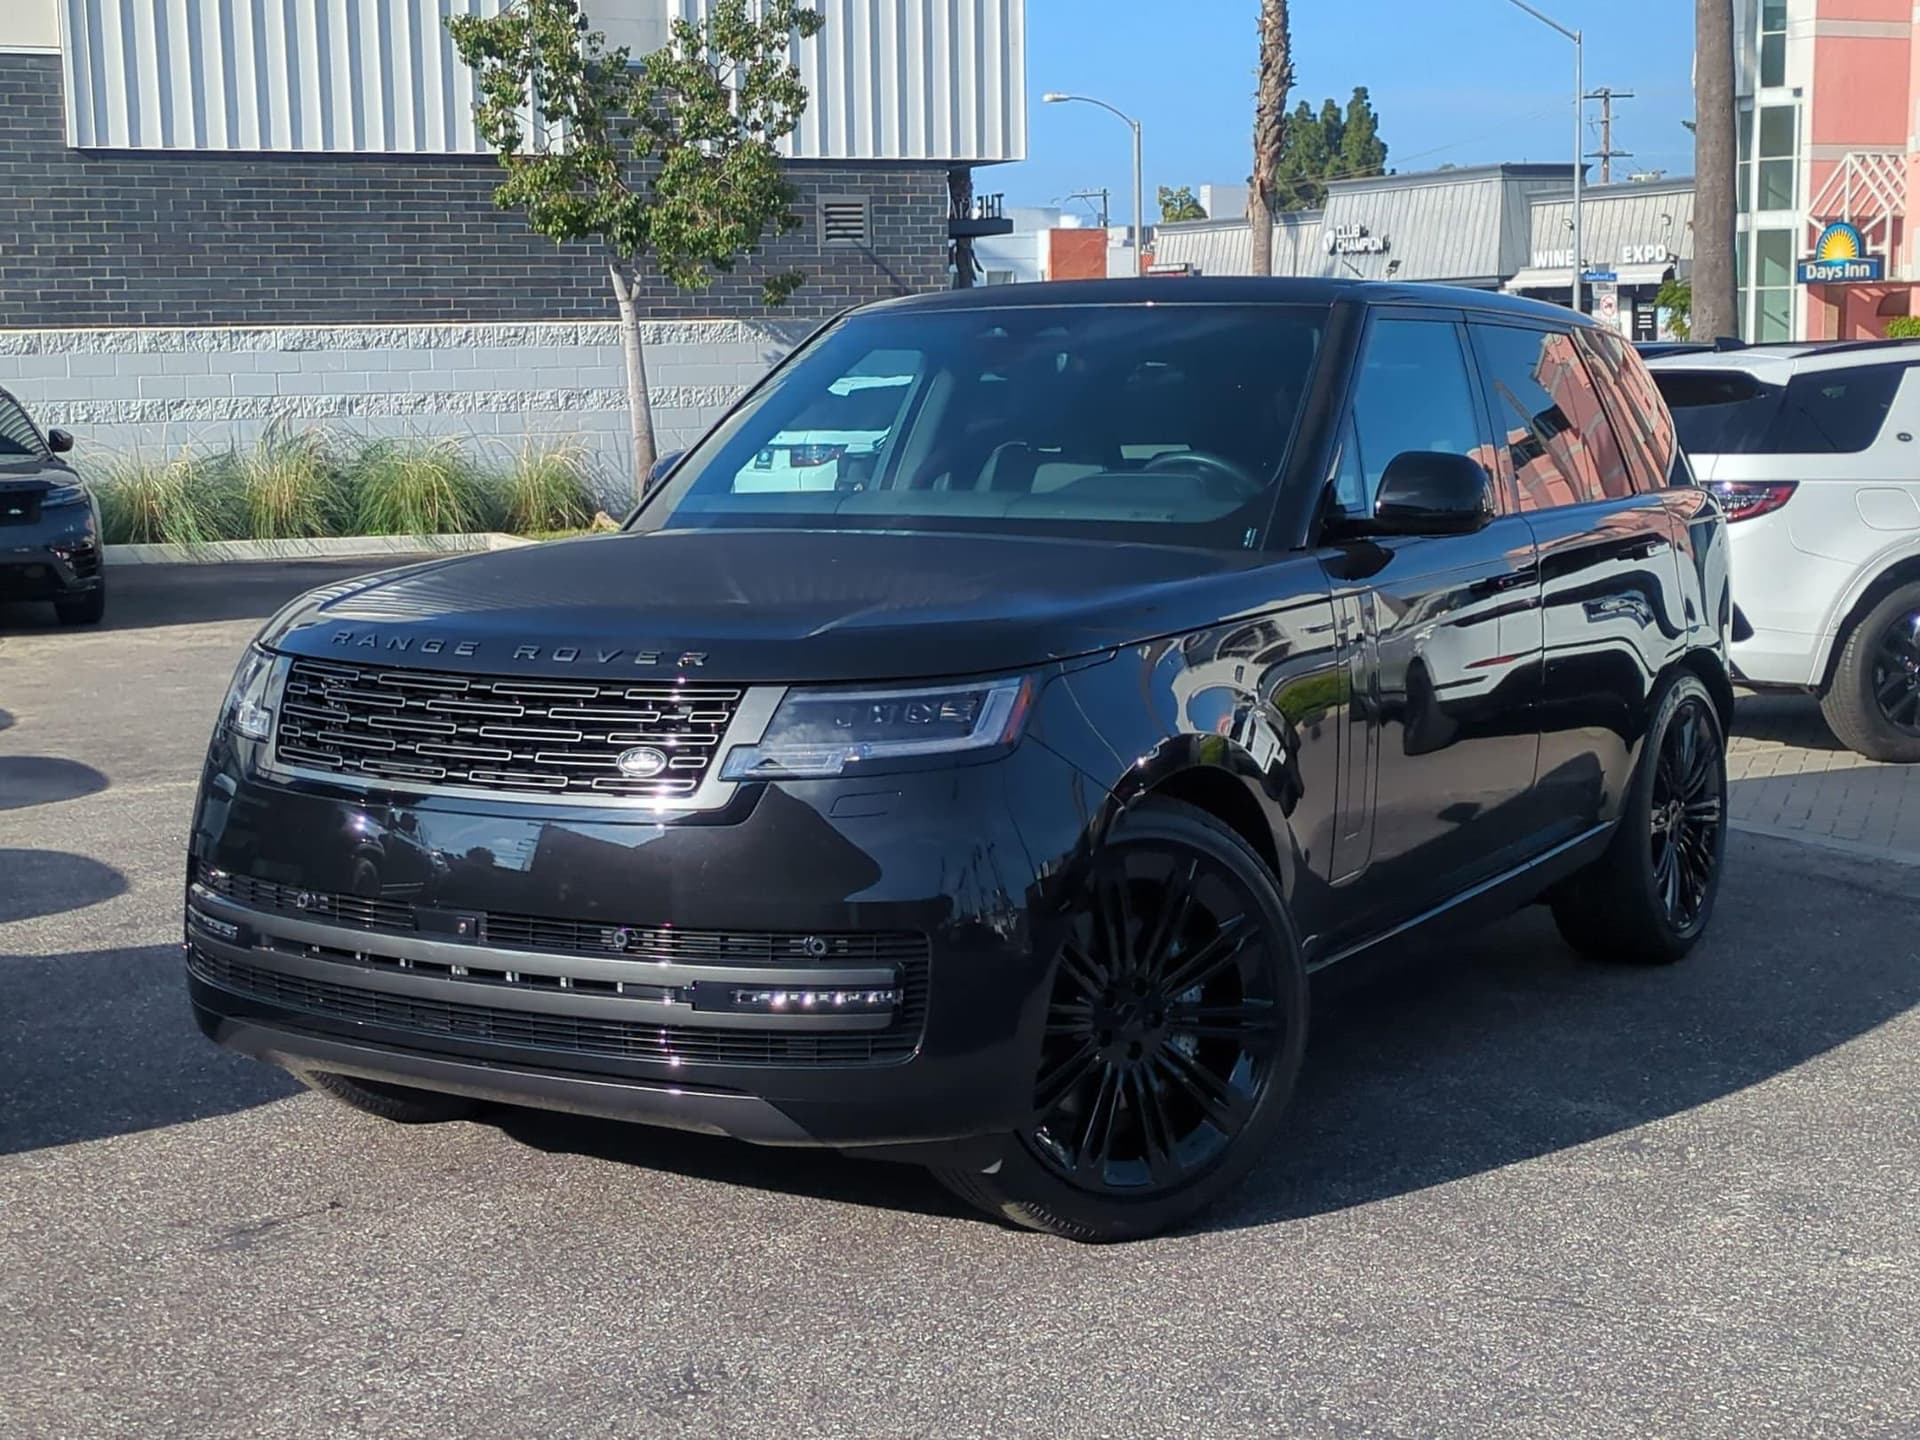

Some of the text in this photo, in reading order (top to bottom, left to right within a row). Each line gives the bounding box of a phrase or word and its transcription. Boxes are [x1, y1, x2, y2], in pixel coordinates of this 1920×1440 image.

[1533, 244, 1667, 268] WINE EXPO
[1806, 262, 1870, 280] Days Inn
[331, 631, 708, 667] RANGE ROVER
